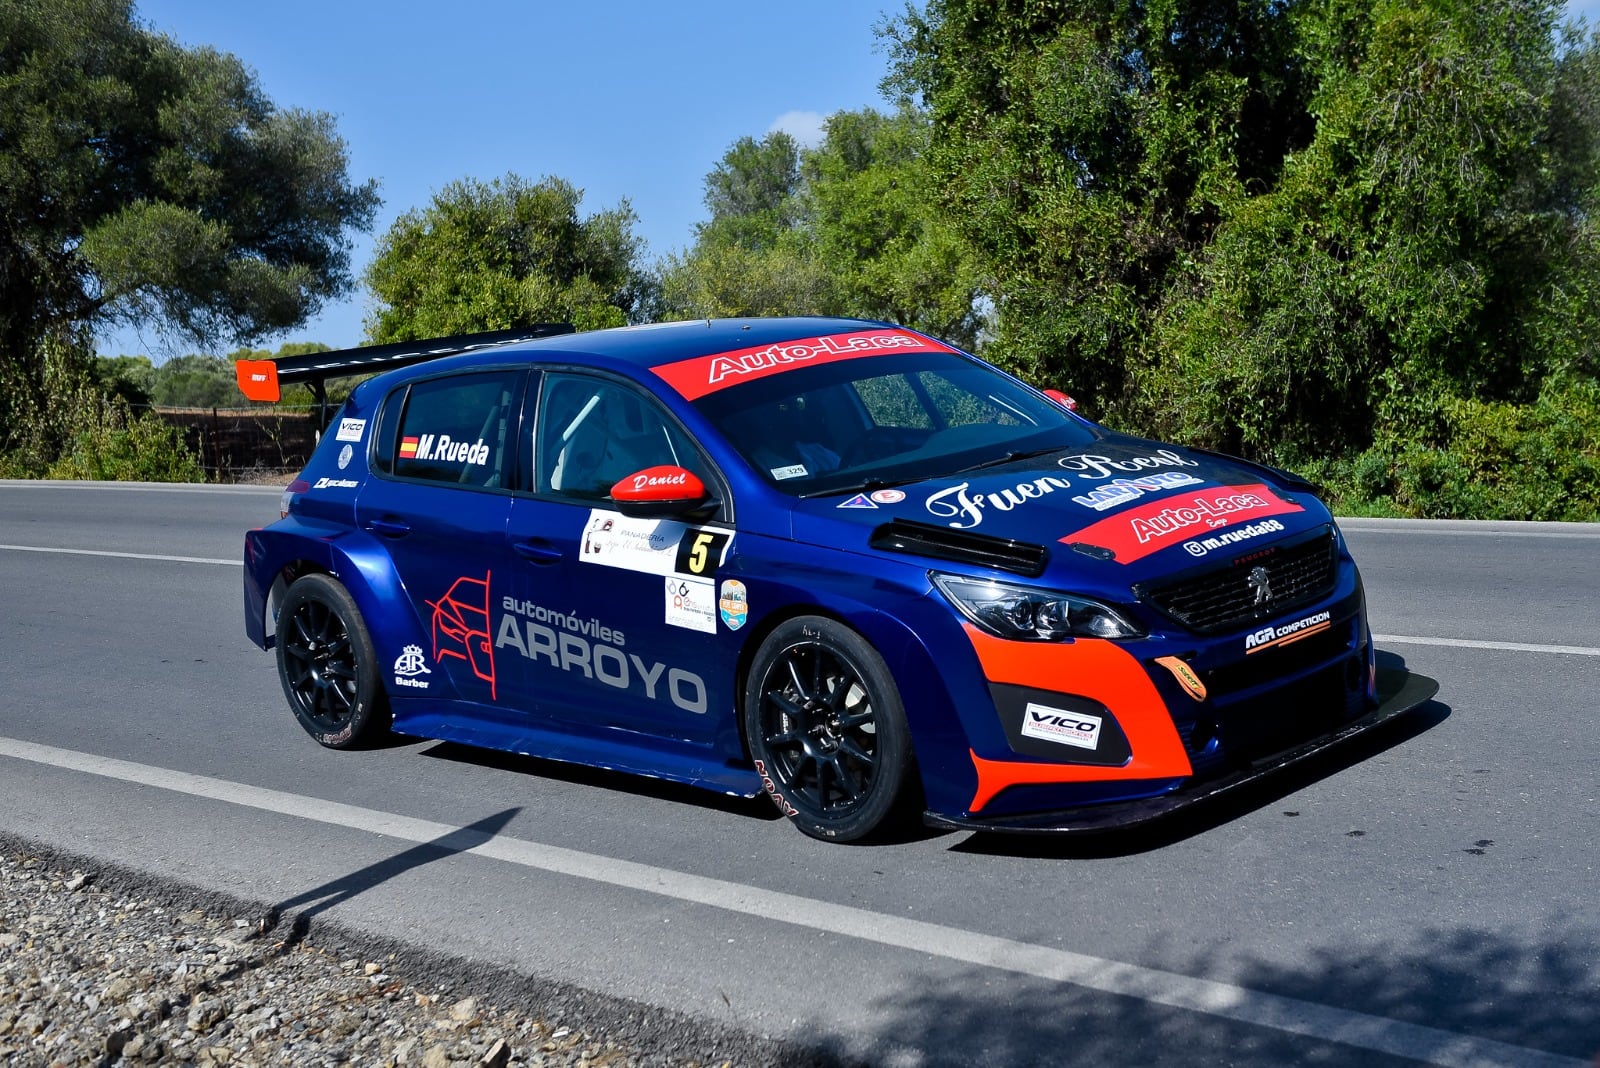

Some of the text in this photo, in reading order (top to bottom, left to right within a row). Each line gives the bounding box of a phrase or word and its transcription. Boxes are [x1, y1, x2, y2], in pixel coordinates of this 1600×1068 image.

[708, 335, 925, 384] Auto-Laca
[415, 433, 489, 466] M.Rueda
[633, 472, 687, 489] Daniel
[925, 476, 1071, 529] Fuen
[1133, 493, 1269, 543] Auto-Laca
[620, 529, 665, 543] PANADERÍA
[688, 533, 714, 574] 5
[1203, 519, 1285, 551] m.rueda88
[502, 595, 626, 646] automóviles
[1276, 611, 1331, 637] COMPETICION
[495, 614, 708, 714] ARROYO
[395, 677, 429, 689] Barber
[1030, 711, 1096, 732] VICO
[754, 760, 800, 817] AVON
